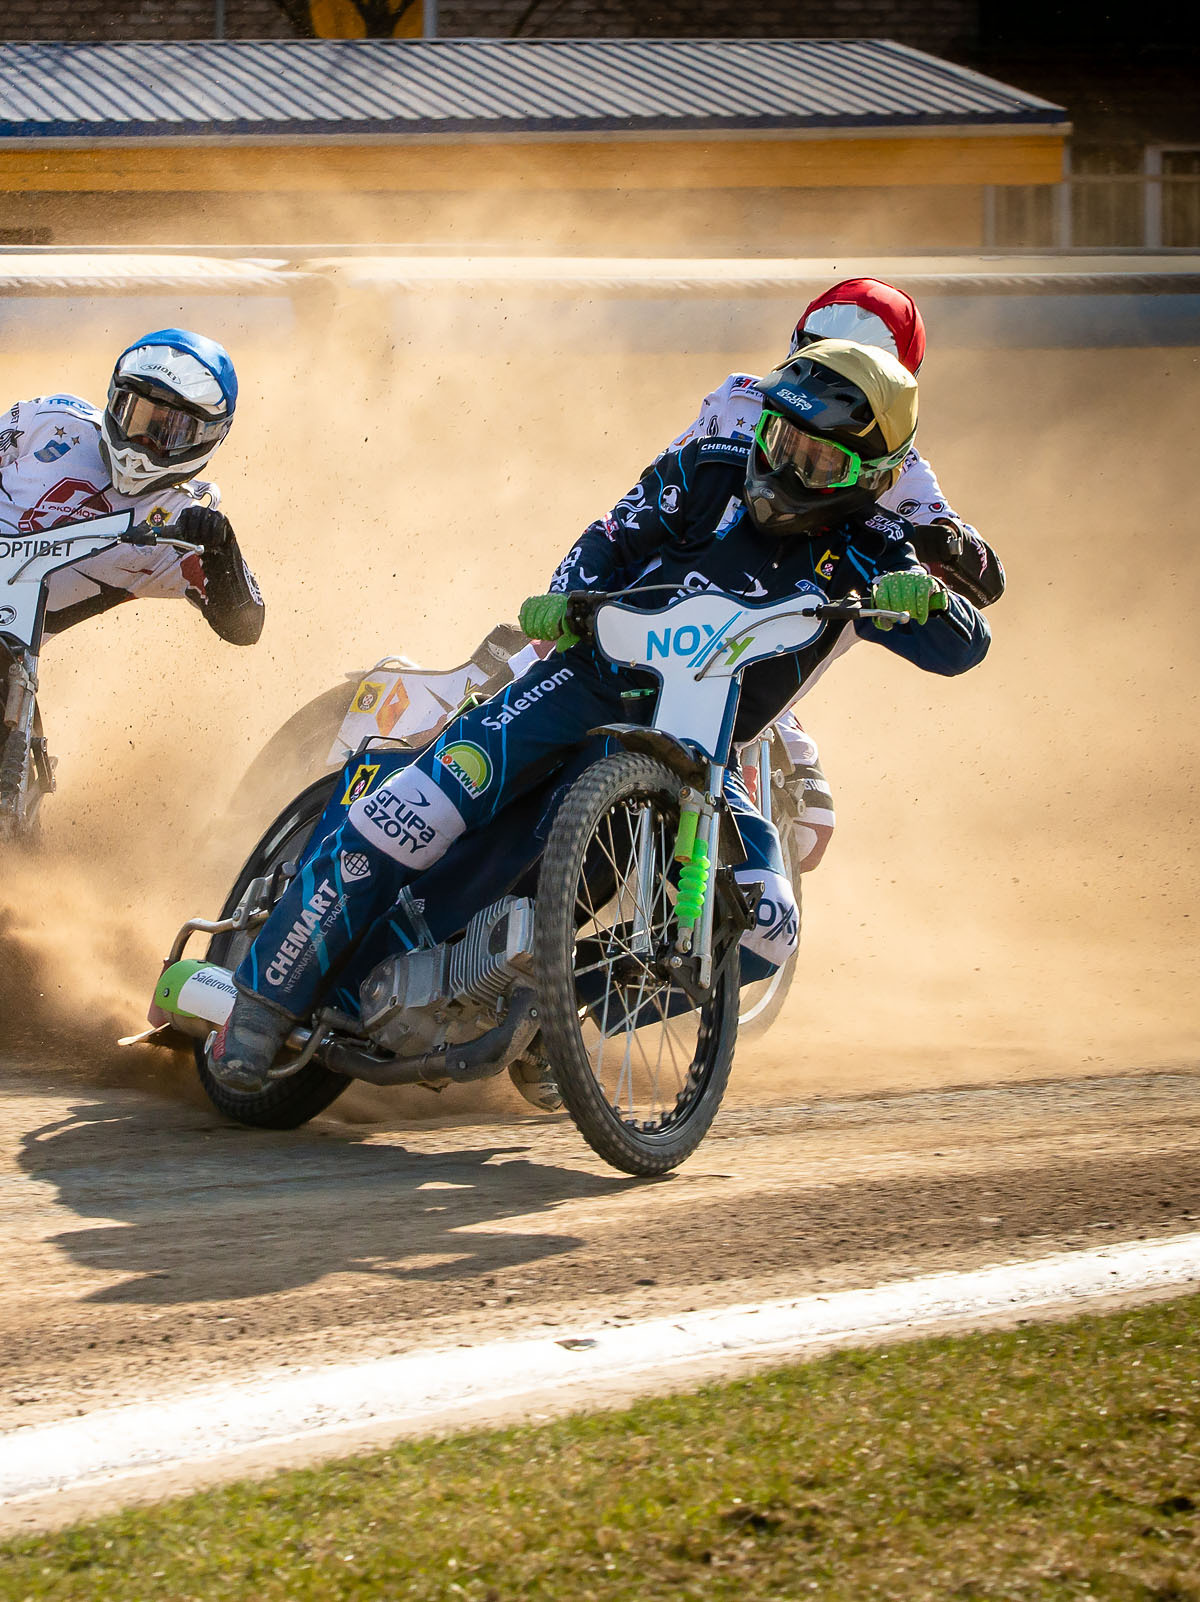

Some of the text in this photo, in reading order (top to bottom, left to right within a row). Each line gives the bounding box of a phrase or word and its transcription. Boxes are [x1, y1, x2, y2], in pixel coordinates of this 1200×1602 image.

[265, 878, 338, 987] CHEMART
[282, 892, 351, 994] INTERNATIONAL TRADER
